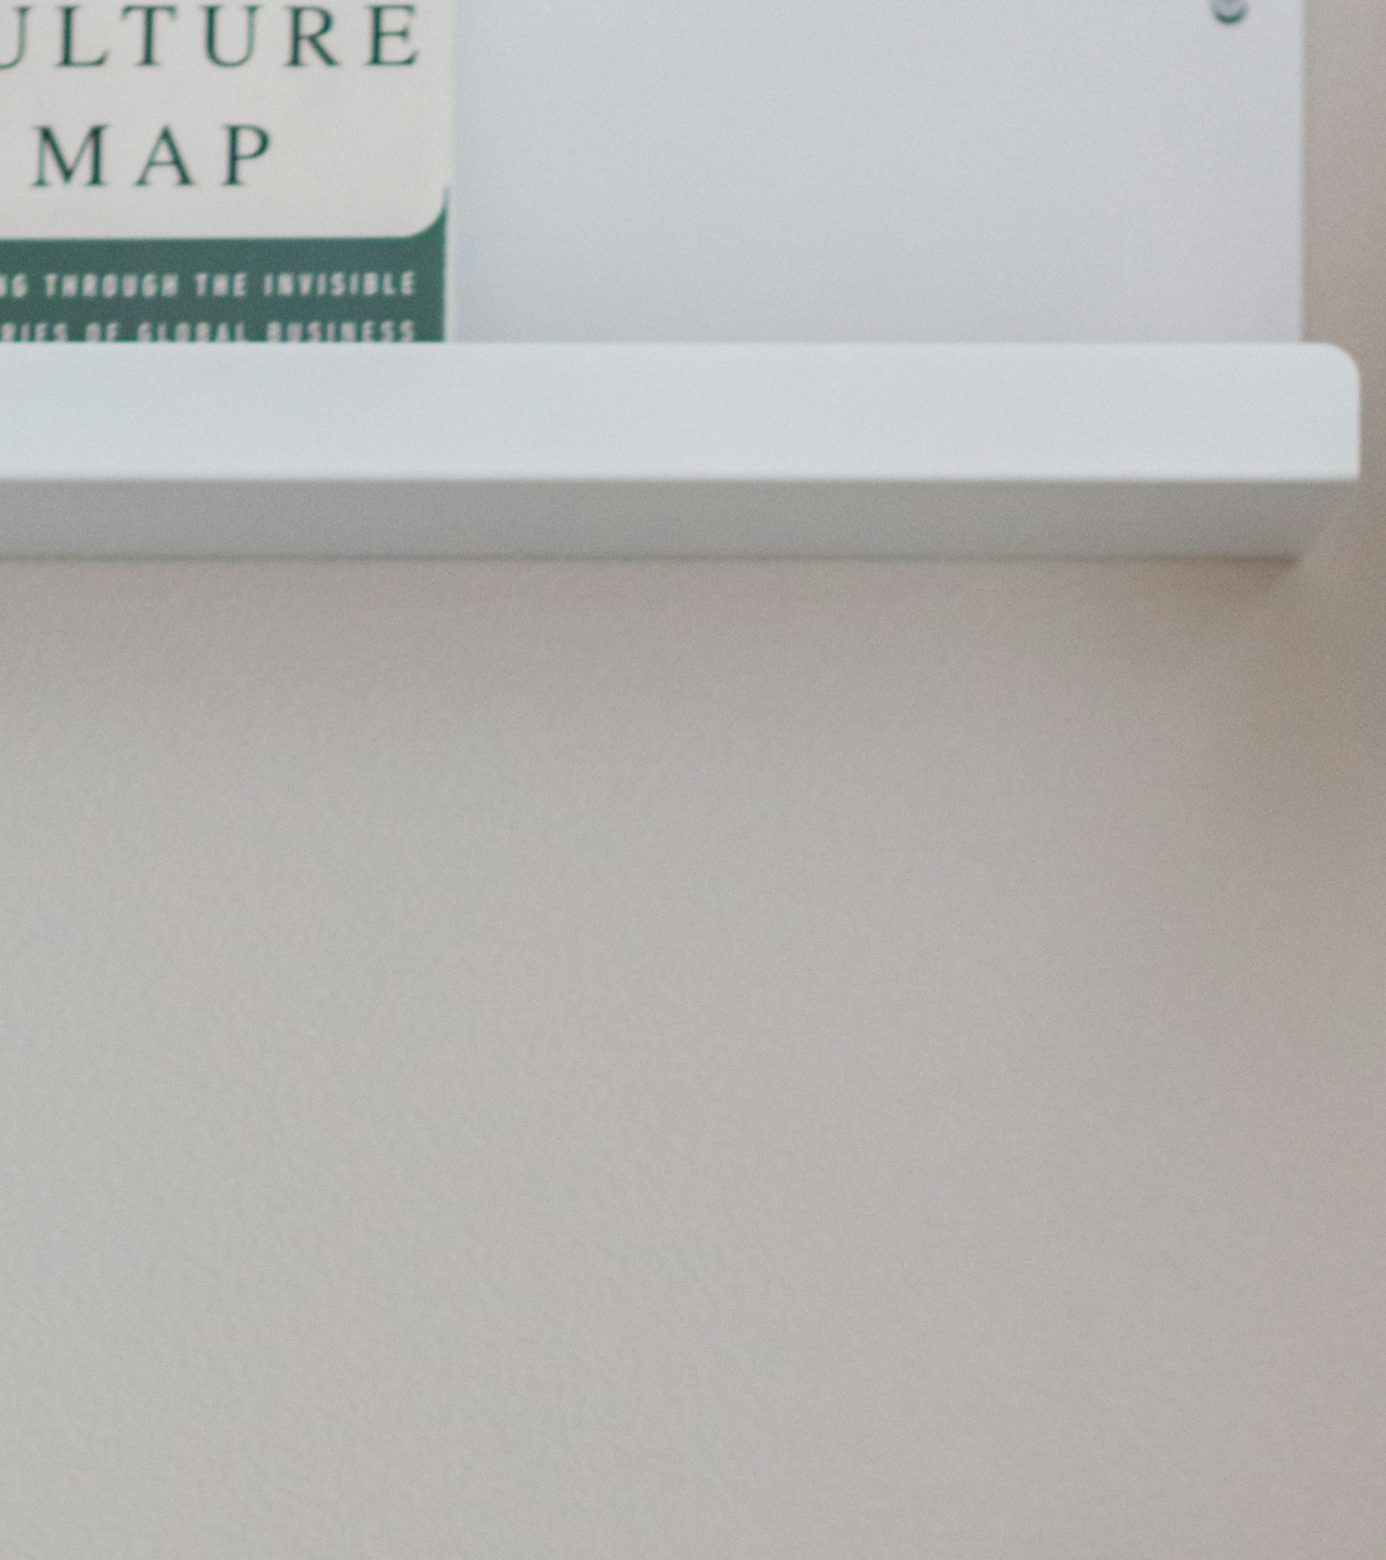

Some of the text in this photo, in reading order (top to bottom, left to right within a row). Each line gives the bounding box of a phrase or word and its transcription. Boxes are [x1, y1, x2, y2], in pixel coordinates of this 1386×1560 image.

[31, 123, 271, 188] MAP
[44, 273, 179, 298] THROUGH
[195, 273, 248, 297] THE
[264, 271, 416, 296] INVISIBLE
